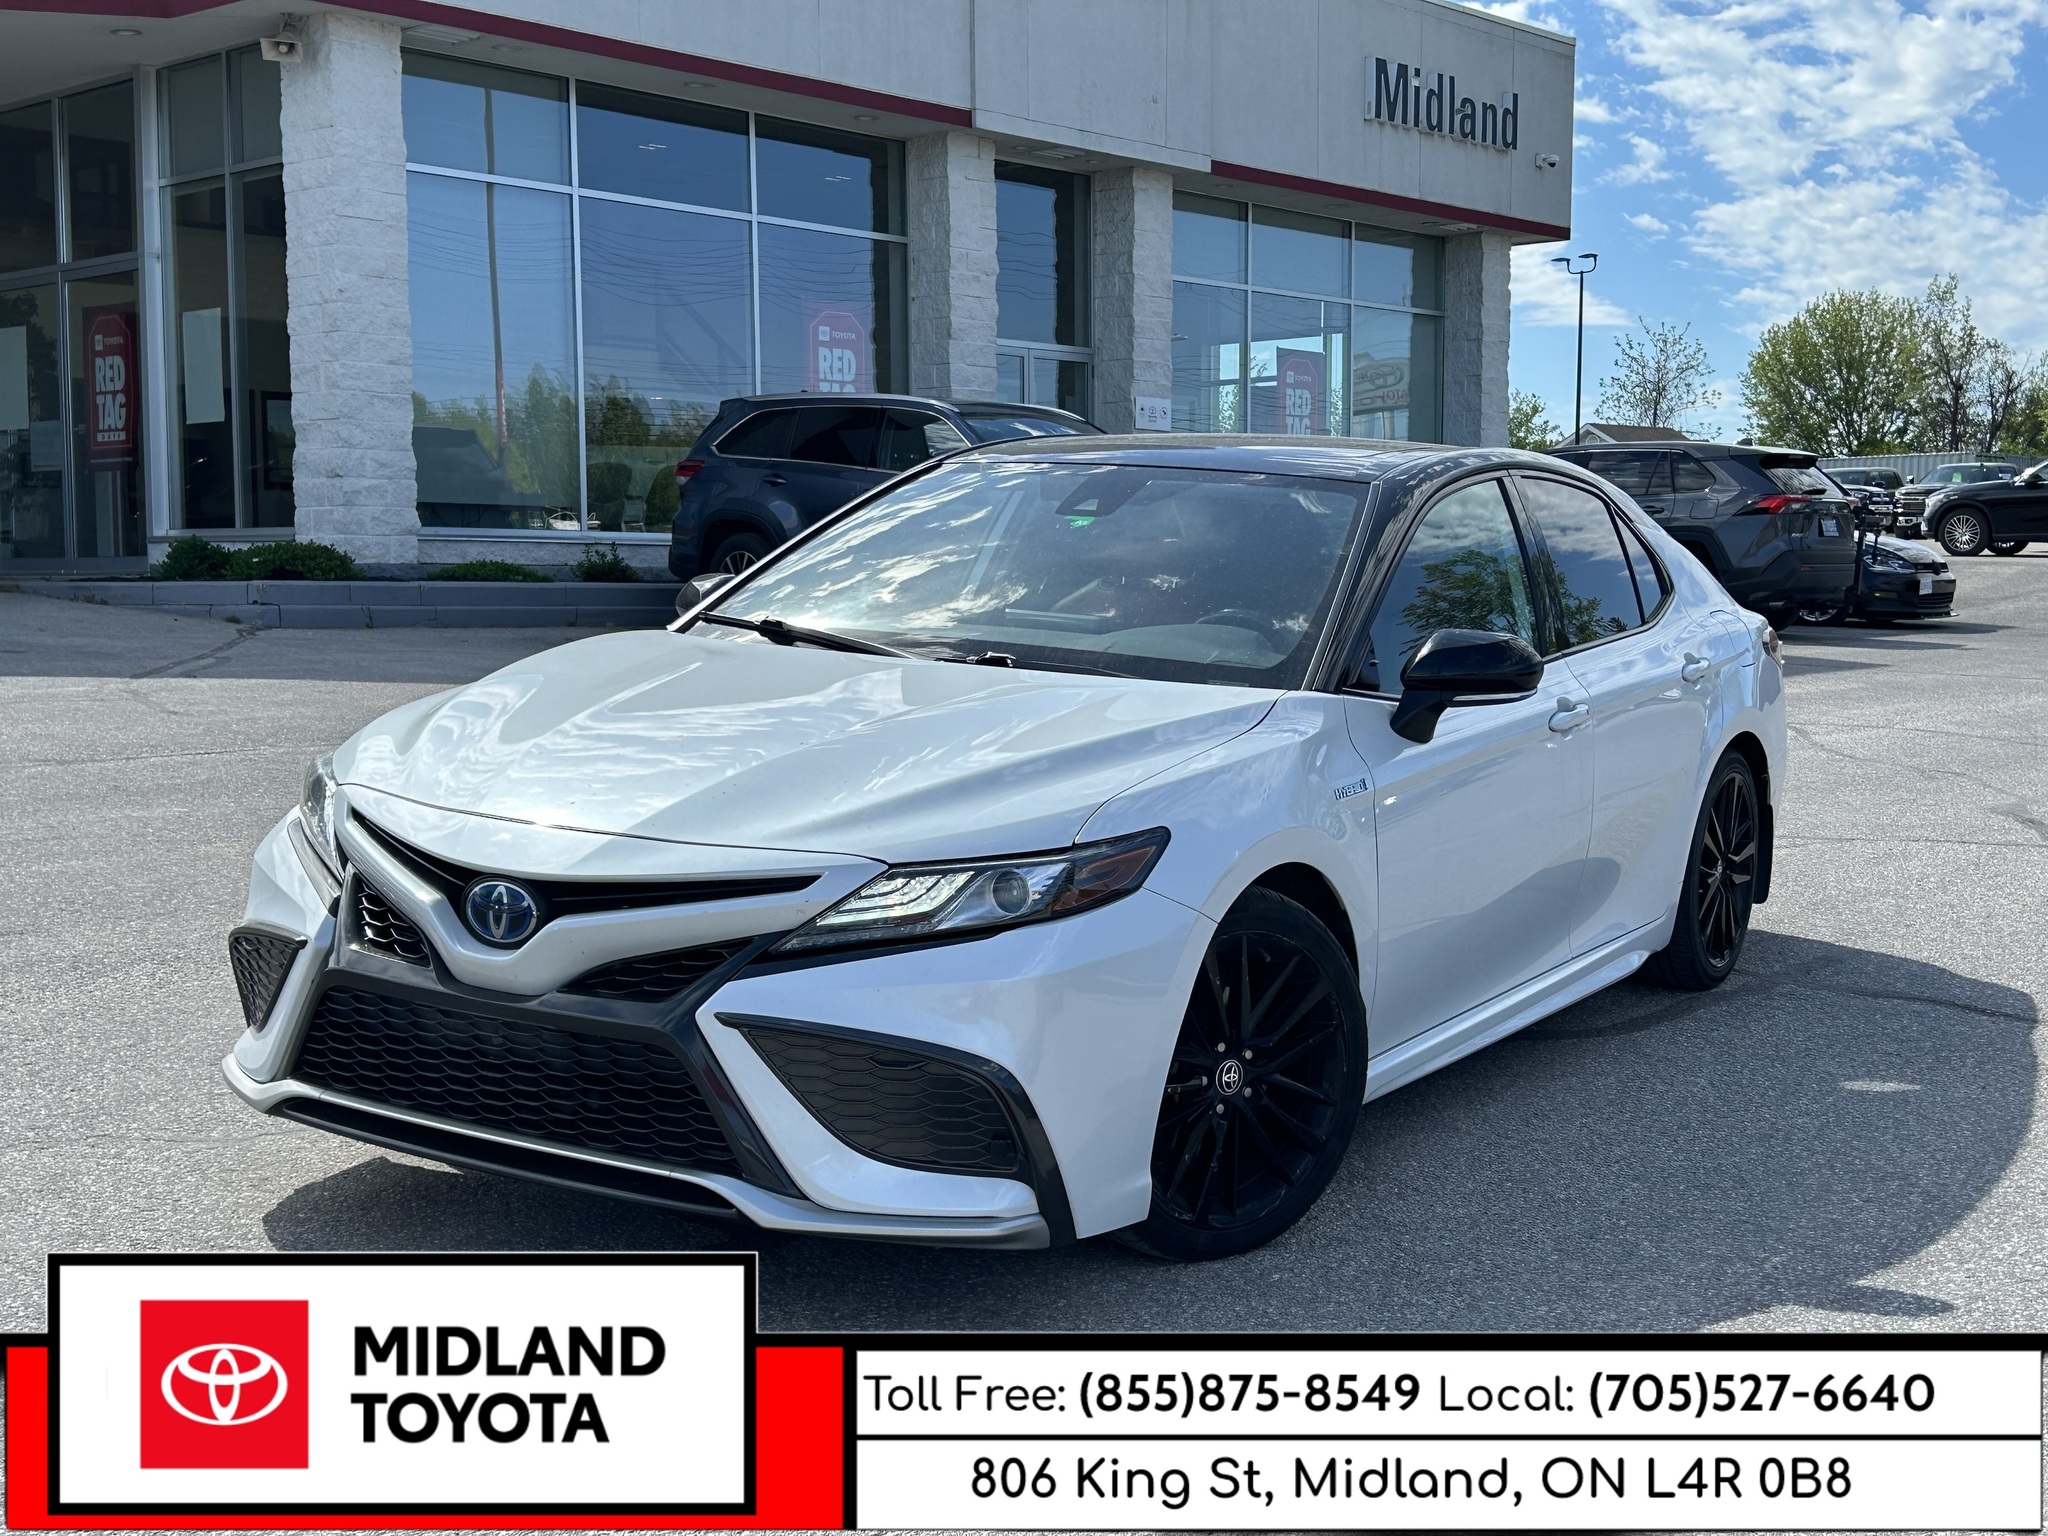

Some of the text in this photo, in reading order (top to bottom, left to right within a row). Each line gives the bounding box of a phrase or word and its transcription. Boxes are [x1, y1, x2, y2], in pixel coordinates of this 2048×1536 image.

[1372, 56, 1519, 151] Midland
[831, 330, 857, 340] TOYOTA
[95, 356, 126, 392] RED
[818, 346, 857, 382] RED
[1294, 373, 1312, 383] TOYOTA
[96, 393, 126, 430] TAG
[1286, 388, 1311, 415] RED
